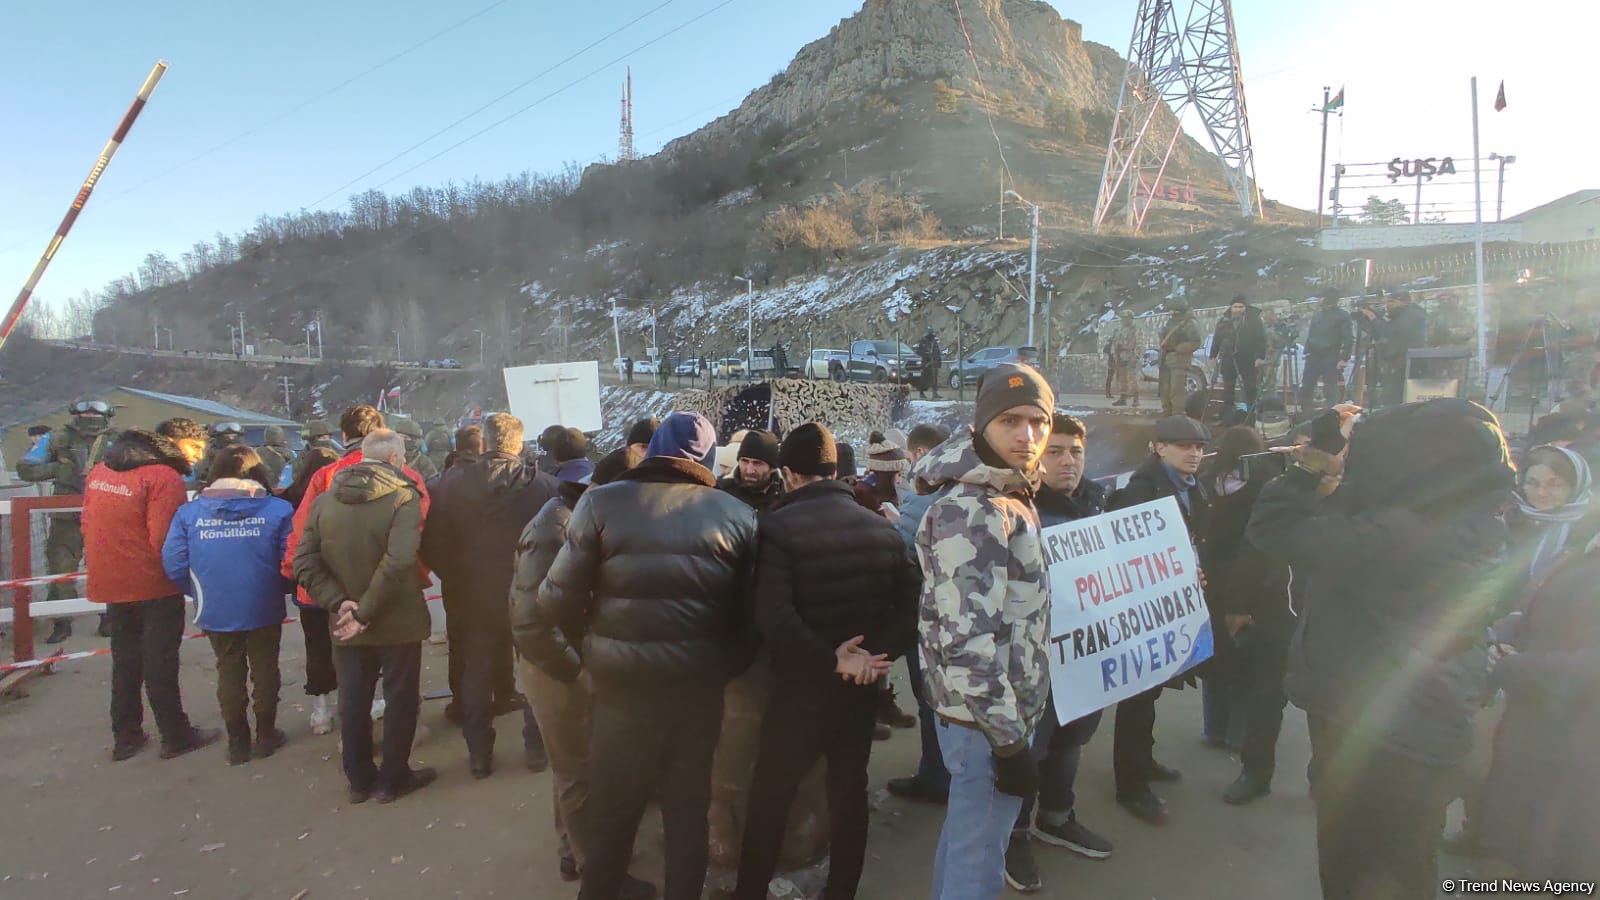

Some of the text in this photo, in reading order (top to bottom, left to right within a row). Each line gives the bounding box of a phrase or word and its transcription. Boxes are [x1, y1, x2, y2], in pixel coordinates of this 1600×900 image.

[1387, 157, 1456, 183] ŞUŞA
[1110, 508, 1166, 545] KEEPS
[1075, 545, 1184, 611] POLLUTING
[1051, 581, 1203, 665] TRANSBOUNDARY
[1101, 623, 1191, 692] RIVERS
